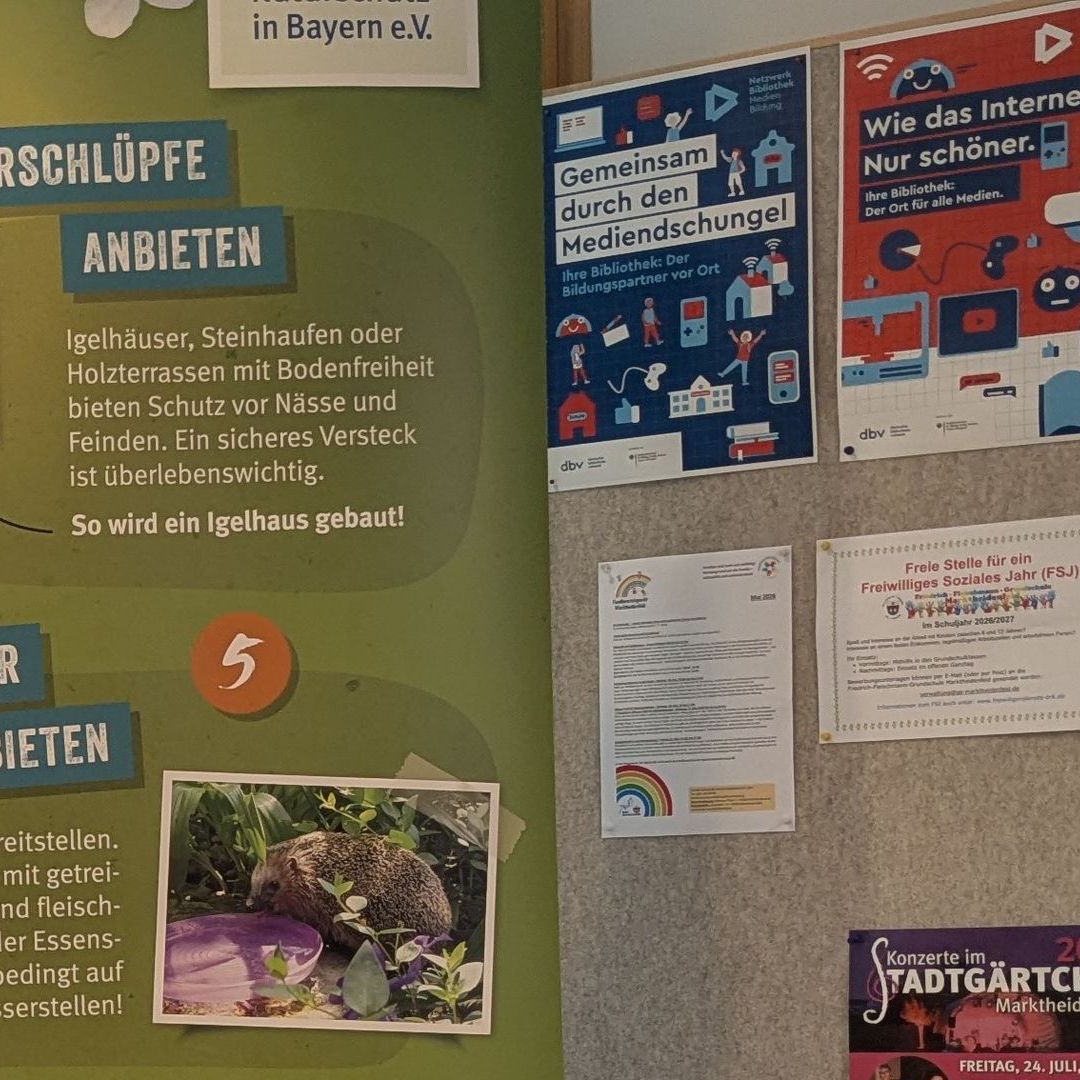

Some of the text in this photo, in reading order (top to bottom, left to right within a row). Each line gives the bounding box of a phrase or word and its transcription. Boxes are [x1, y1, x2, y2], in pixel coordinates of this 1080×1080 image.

[253, 13, 432, 46] in Bayern e.V.
[749, 78, 794, 95] Bibliothek
[863, 89, 1080, 139] Wie das Interne
[560, 147, 708, 188] Gemeinsam
[864, 135, 1036, 176] Nur schöner.
[561, 184, 688, 222] durch den
[865, 179, 955, 203] Ihre Bibliothek:
[865, 189, 1004, 217] Der Ort für alle Medien.
[562, 197, 787, 257] Mediendschungel
[83, 226, 261, 273] ANBIETEN
[562, 254, 690, 283] Ihre Bibliothek: Der
[562, 263, 721, 297] Bildungspartner vor Ort
[67, 321, 403, 355] Igelhäuser, Steinhaufen oder
[68, 355, 435, 385] Holzterrassen mit Bodenfreiheit
[68, 389, 396, 419] bieten Schutz vor Nässe und
[69, 422, 417, 453] Feinden. Ein sicheres Versteck
[859, 428, 885, 441] dbv
[560, 460, 584, 472] dbv
[71, 505, 404, 538] So wird ein Igelhaus gebaut!
[905, 552, 1032, 574] Freie Stelle für ein
[861, 578, 939, 594] Freiwilliges
[942, 572, 1001, 587] Soziales
[1005, 569, 1038, 582] Jahr
[1041, 564, 1079, 582] (FSJ)
[934, 619, 973, 629] Schuljahr
[218, 633, 264, 690] 5
[3, 863, 40, 886] mit
[46, 861, 120, 889] getrei-
[37, 894, 120, 918] fleisch-
[887, 948, 986, 966] Konzerte im
[959, 1060, 1020, 1074] FREITAG,
[1023, 1060, 1046, 1073] 24.
